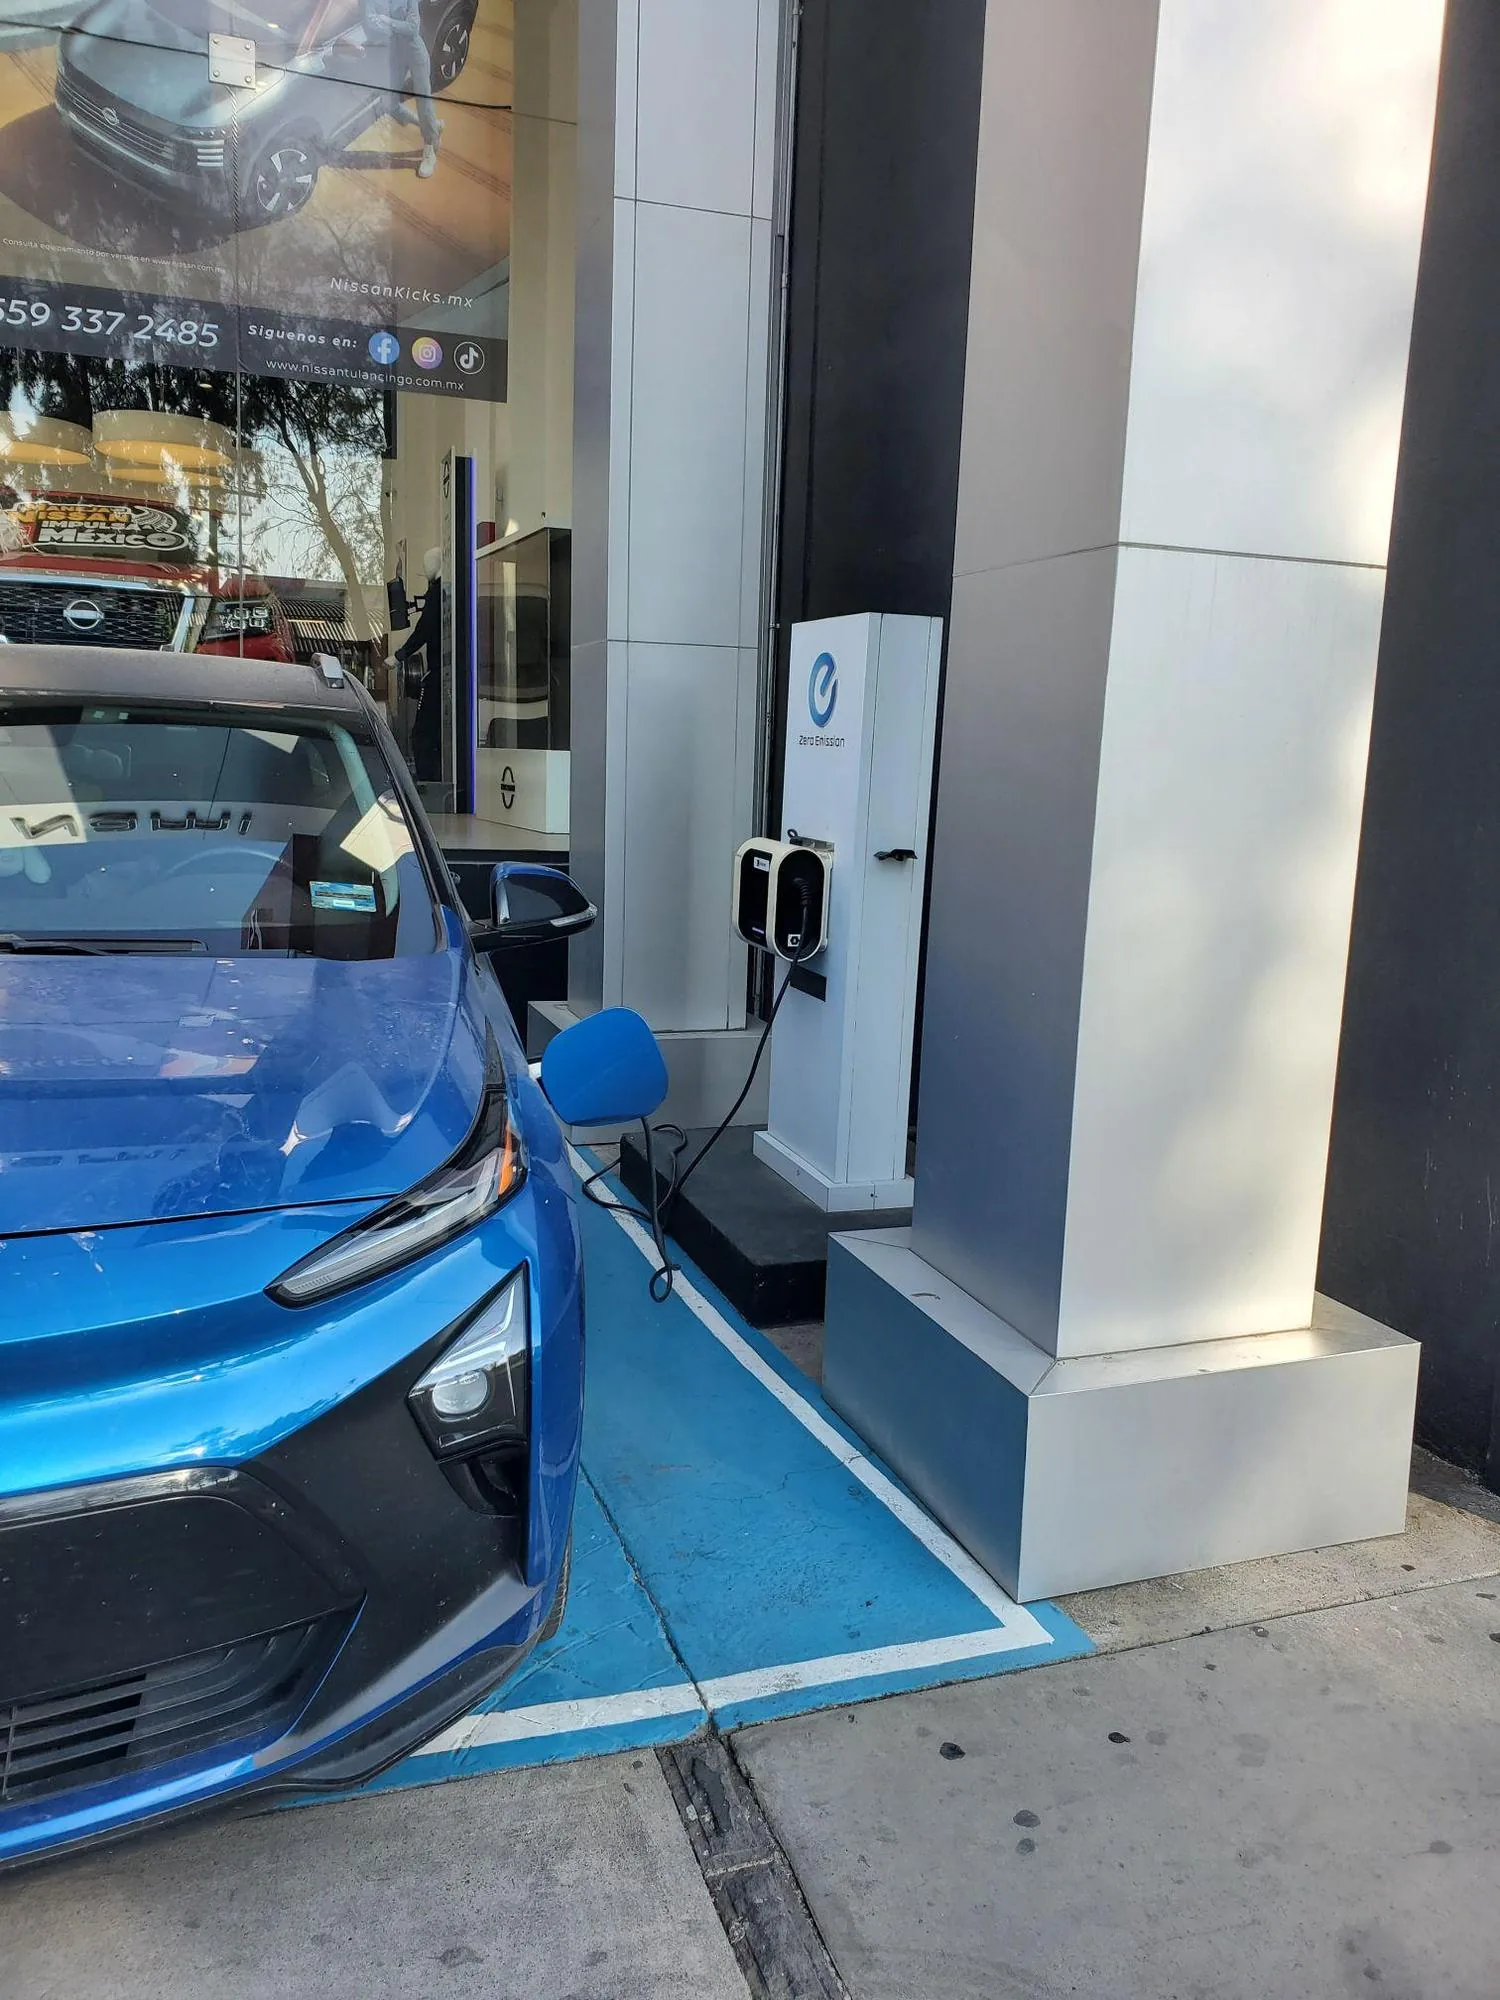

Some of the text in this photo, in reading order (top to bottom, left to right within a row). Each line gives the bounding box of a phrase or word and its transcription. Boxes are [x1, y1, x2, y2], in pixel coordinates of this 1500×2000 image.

[2, 238, 38, 249] Consulta
[330, 277, 473, 308] NissanKicks.mx
[0, 298, 219, 347] 59 337 2485
[332, 336, 358, 349] en:
[265, 358, 465, 391] www.nissantulancingo.com.mx
[799, 735, 845, 748] Zero Emission
